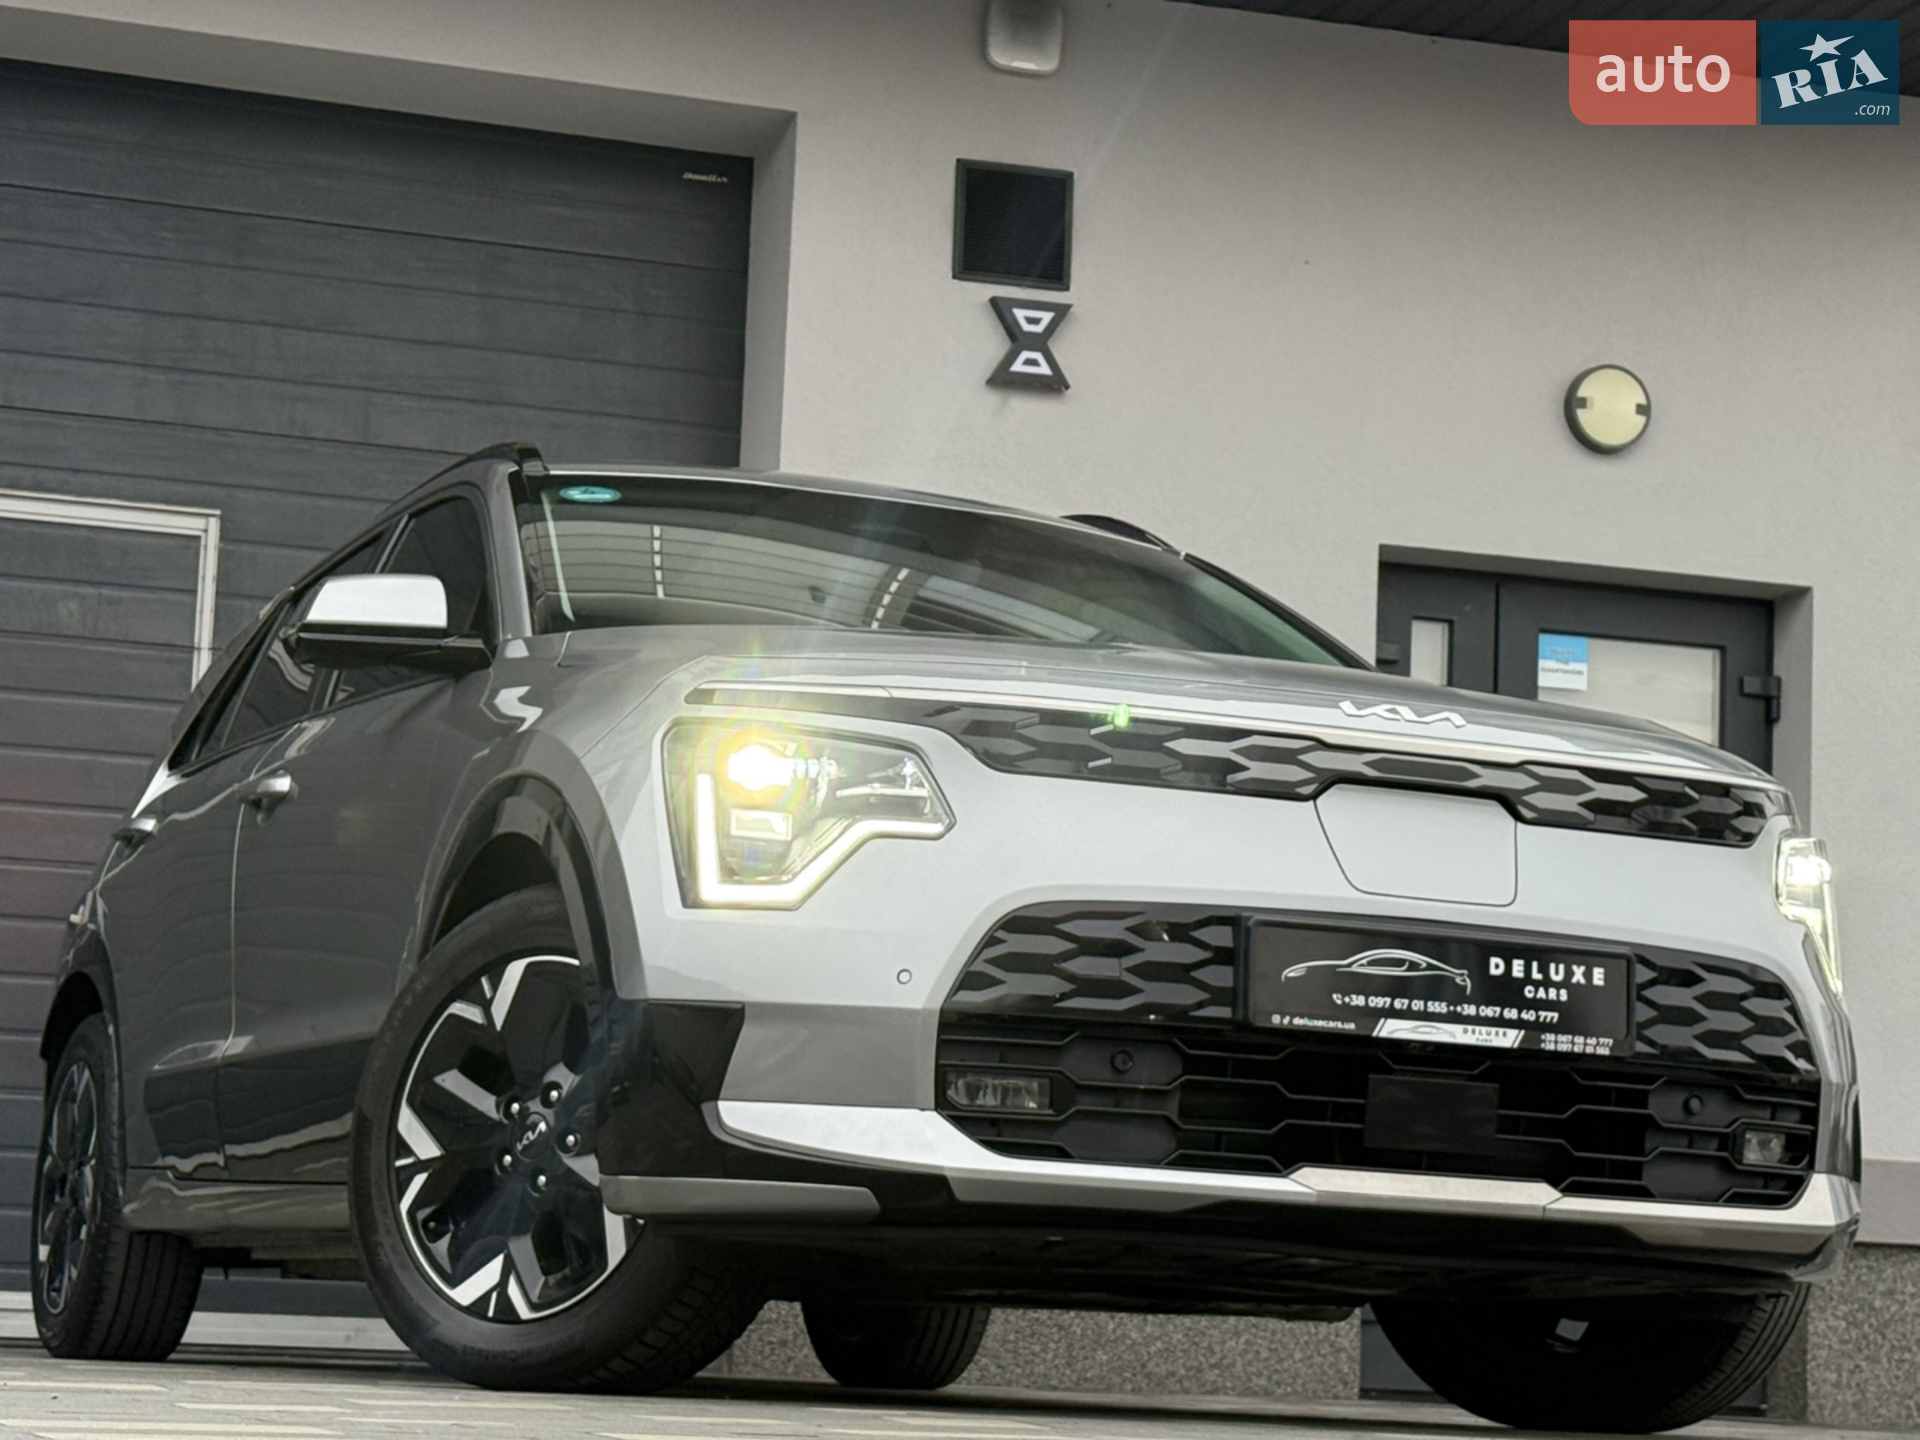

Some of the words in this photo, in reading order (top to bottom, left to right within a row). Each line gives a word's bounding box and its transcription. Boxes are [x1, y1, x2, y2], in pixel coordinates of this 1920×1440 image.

[1488, 956, 1605, 987] DELUXE
[1524, 985, 1568, 1002] CARS
[1344, 994, 1366, 1007] +38
[1367, 995, 1392, 1008] 097
[1393, 998, 1410, 1010] 67
[1411, 999, 1425, 1011] 01
[1426, 1000, 1448, 1013] 555
[1456, 1003, 1477, 1016] +38
[1478, 1004, 1502, 1018] 067
[1502, 1007, 1518, 1020] 68
[1520, 1009, 1537, 1021] 40
[1537, 1010, 1560, 1024] 777
[1292, 1016, 1356, 1030] deluxecars.ua
[1462, 1027, 1508, 1038] DELUXE
